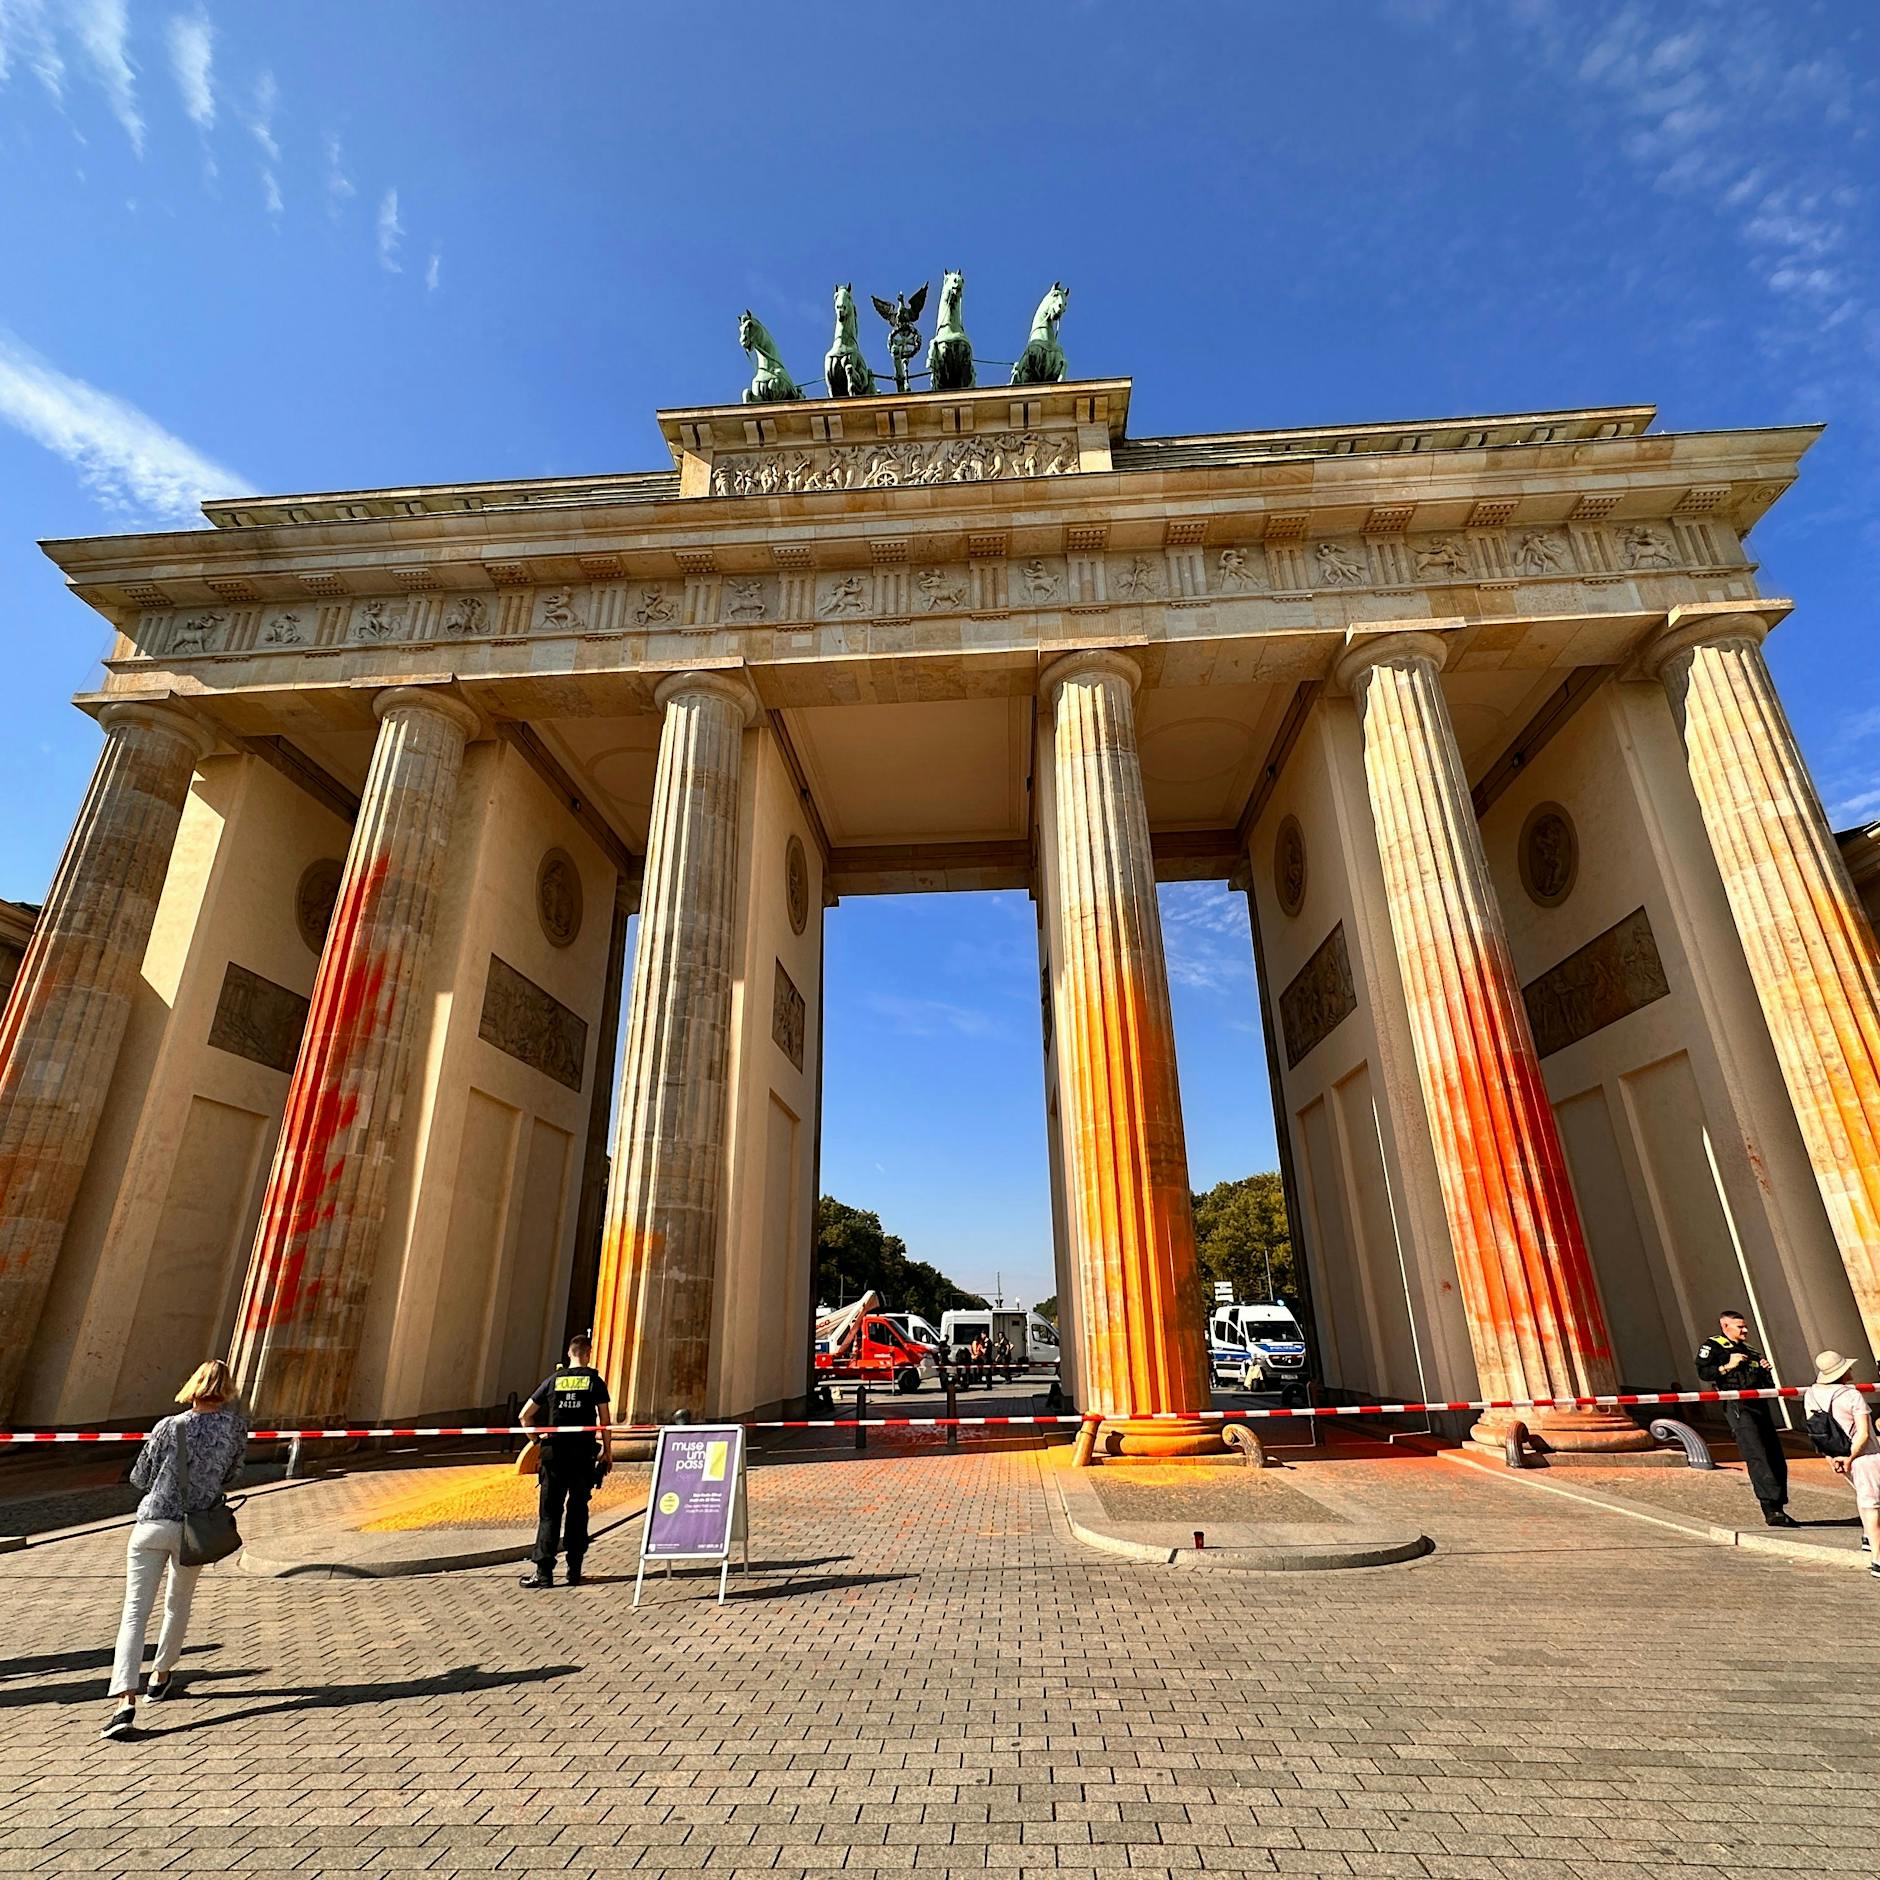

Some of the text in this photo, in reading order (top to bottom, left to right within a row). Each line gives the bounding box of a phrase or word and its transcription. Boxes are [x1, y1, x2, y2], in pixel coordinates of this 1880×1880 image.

[565, 1392, 577, 1401] BE
[671, 1441, 705, 1451] muse
[686, 1450, 706, 1460] um
[675, 1459, 704, 1472] pass
